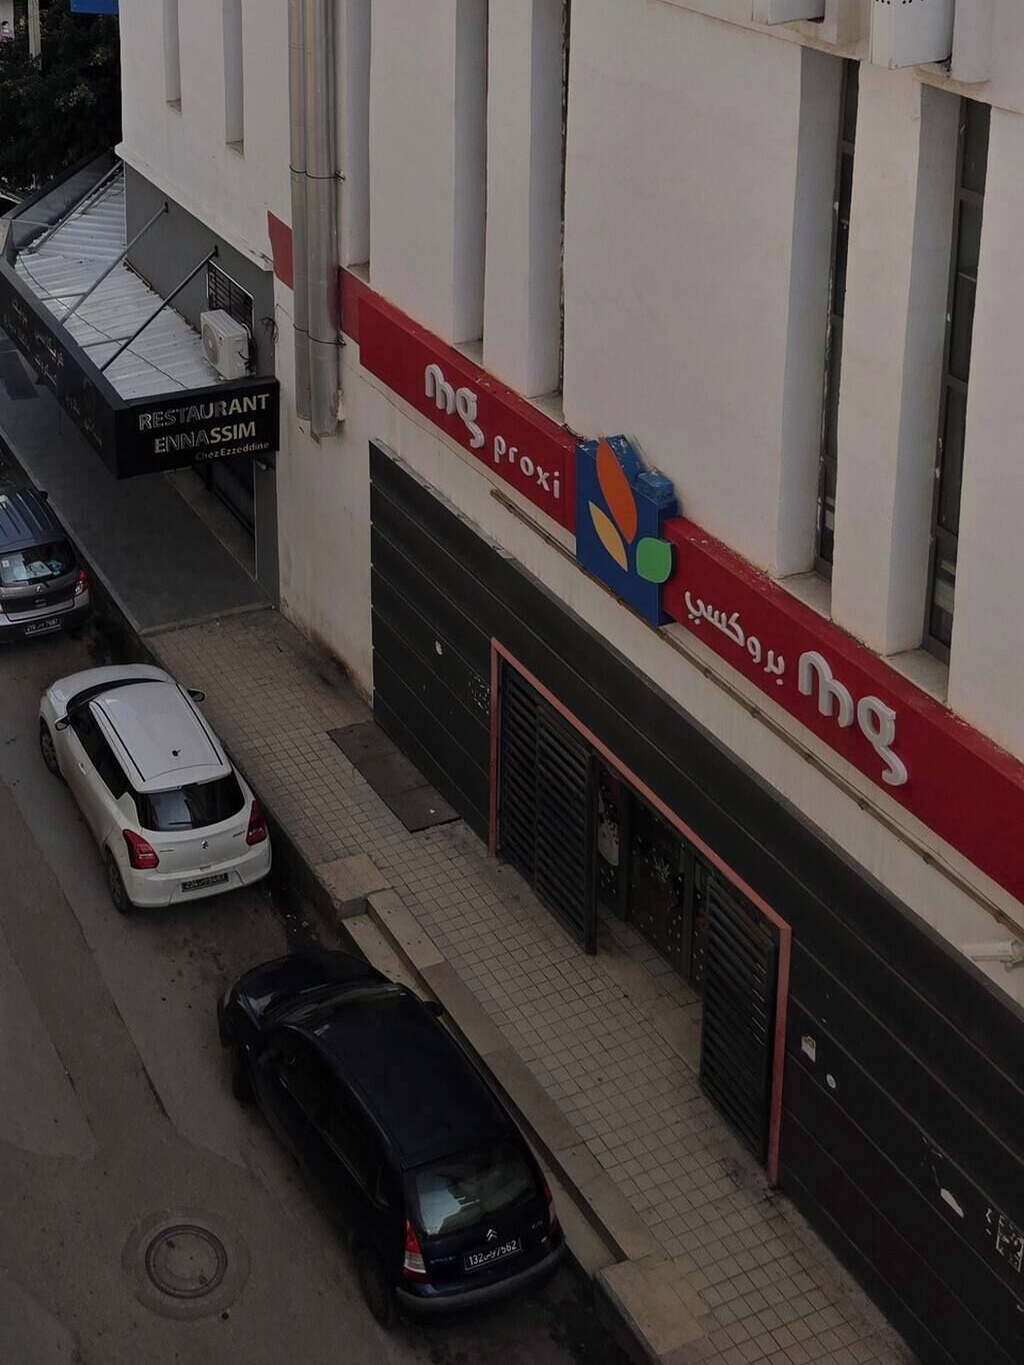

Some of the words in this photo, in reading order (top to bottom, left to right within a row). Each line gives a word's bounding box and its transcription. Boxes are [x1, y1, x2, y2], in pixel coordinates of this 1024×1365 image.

[139, 393, 270, 431] RESTAURANT
[154, 421, 257, 454] ENNASSIM
[195, 448, 220, 460] Chez
[220, 442, 270, 457] Ezzeddine
[494, 435, 560, 498] proxi
[685, 591, 785, 685] بروكسي
